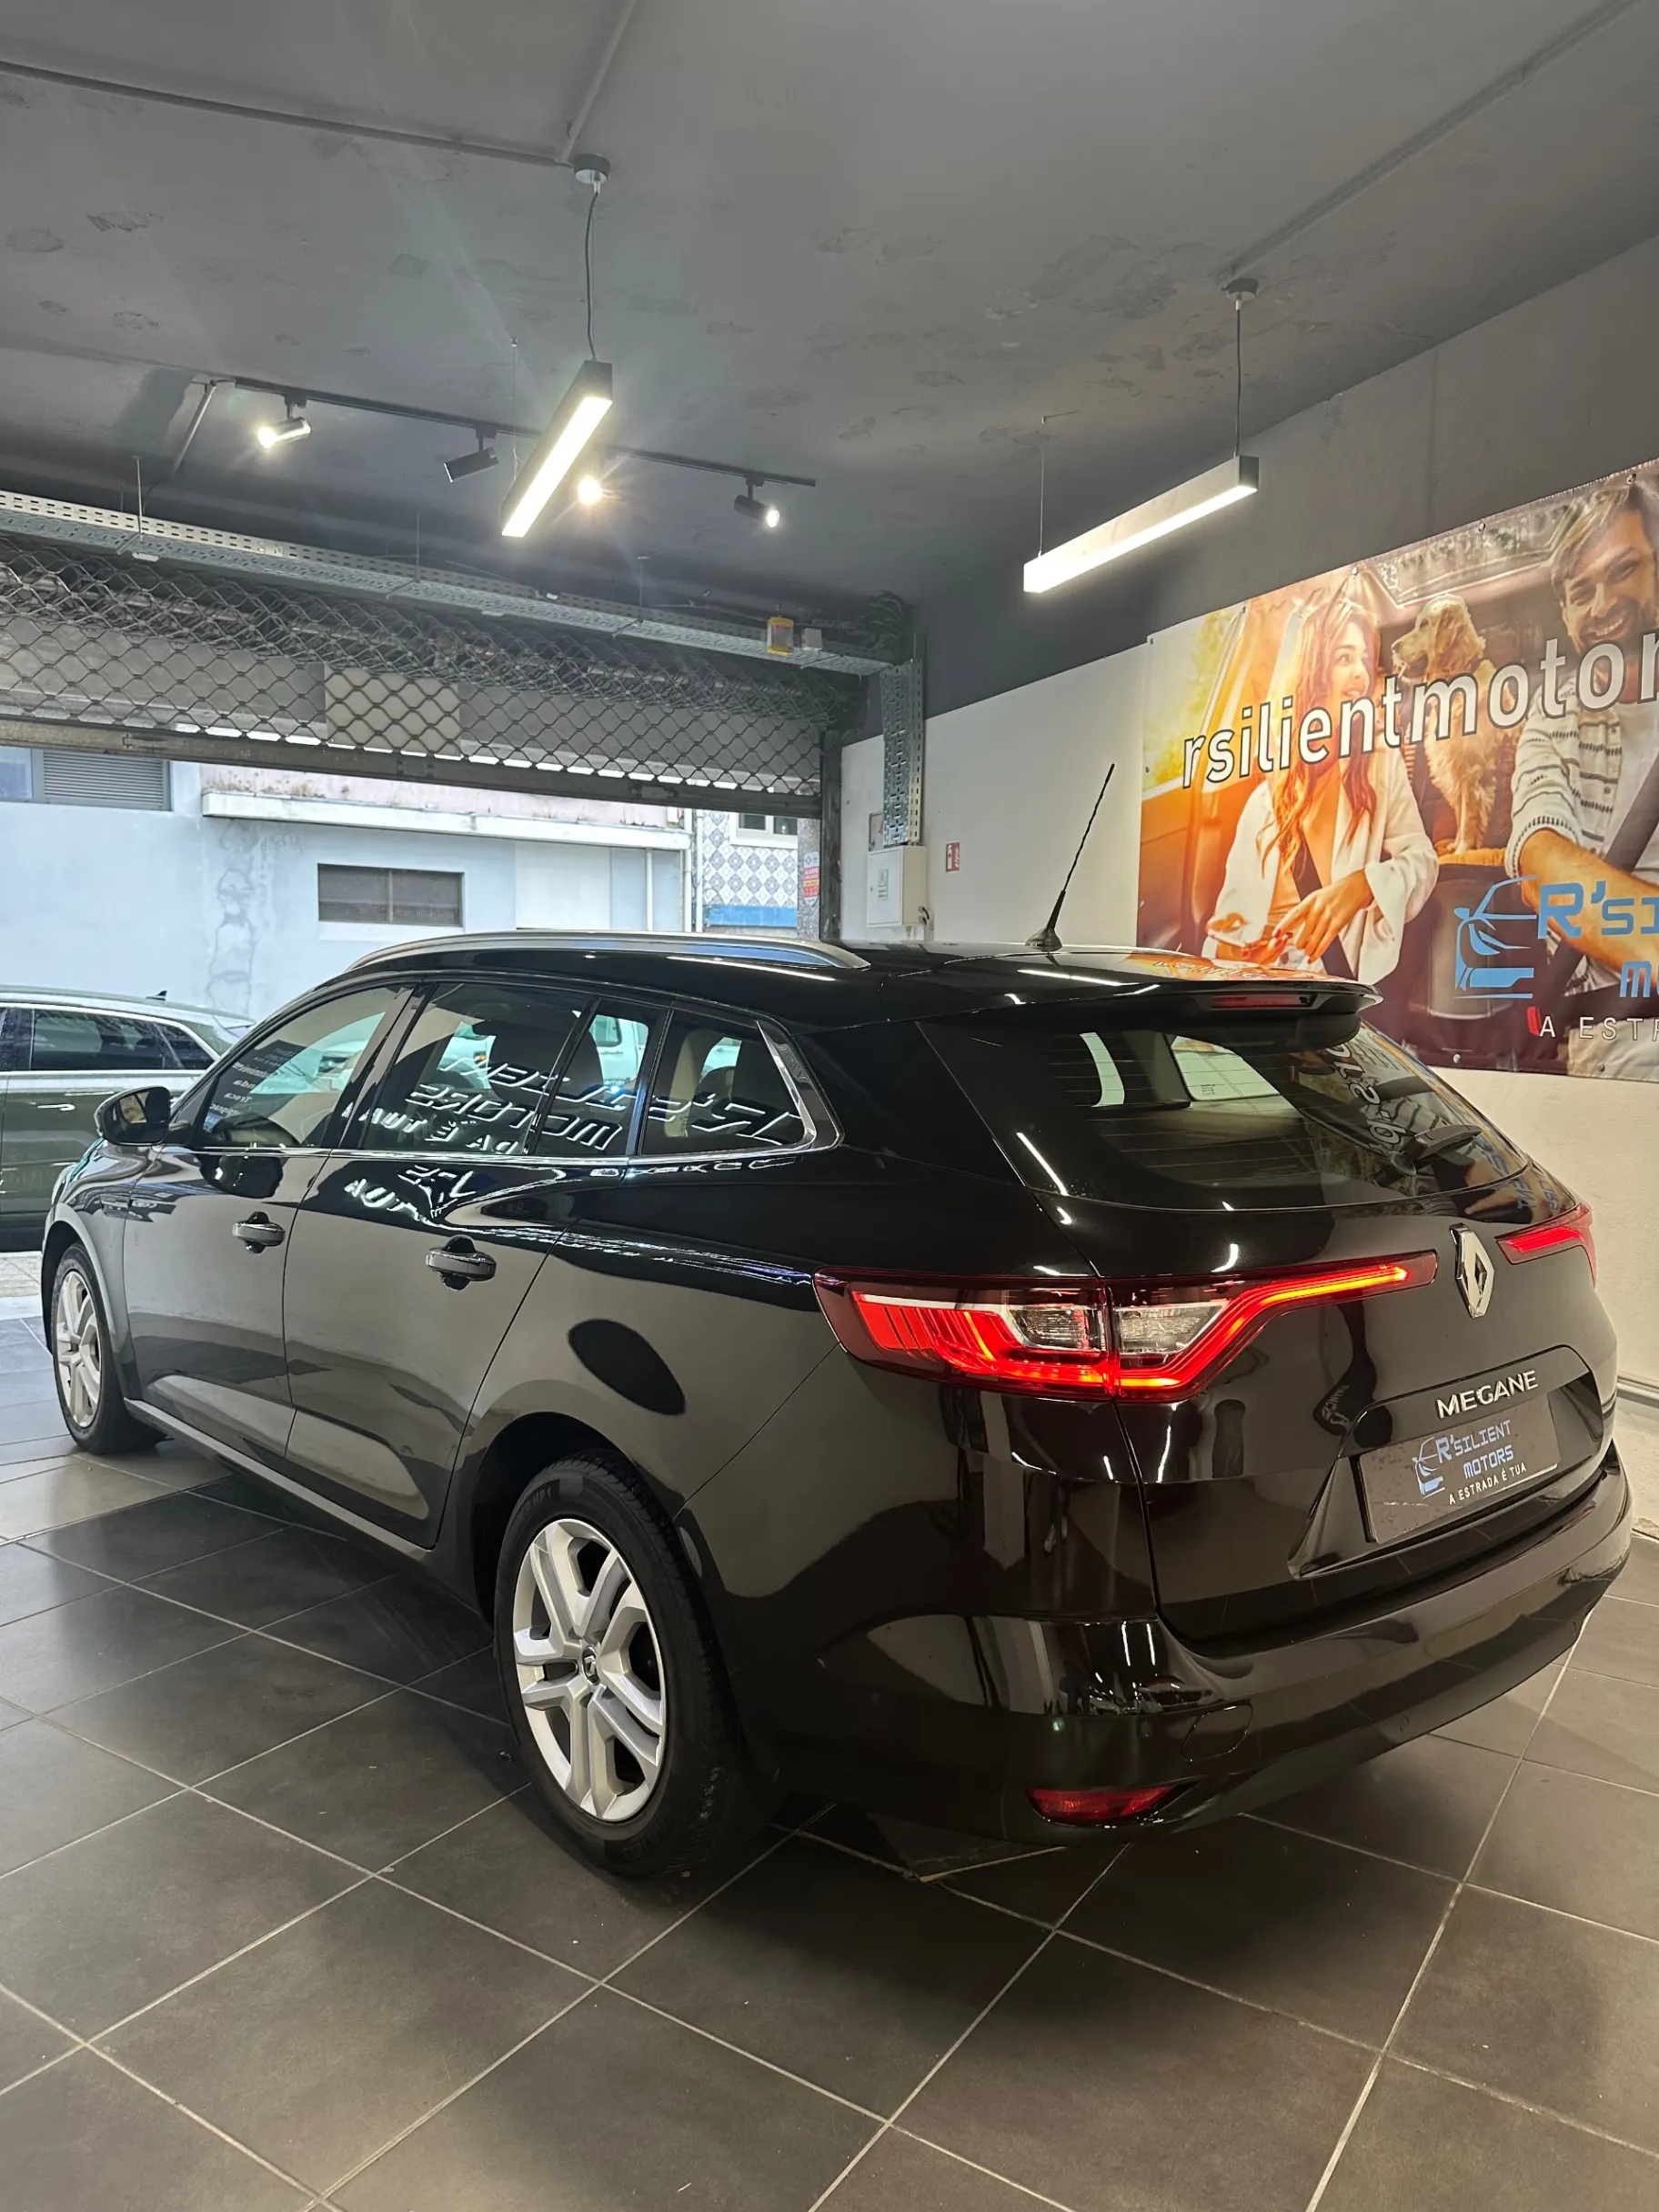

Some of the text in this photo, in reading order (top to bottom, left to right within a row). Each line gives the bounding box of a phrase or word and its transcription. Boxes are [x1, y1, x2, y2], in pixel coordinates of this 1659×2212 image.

[1619, 960, 1659, 998] M
[1539, 1015, 1556, 1038] A
[1435, 1370, 1539, 1419] MEGANE
[1435, 1419, 1512, 1463] R'SILIENT
[1463, 1444, 1514, 1480] MOTORS
[1449, 1462, 1527, 1505] A ESTRADA É TUA
